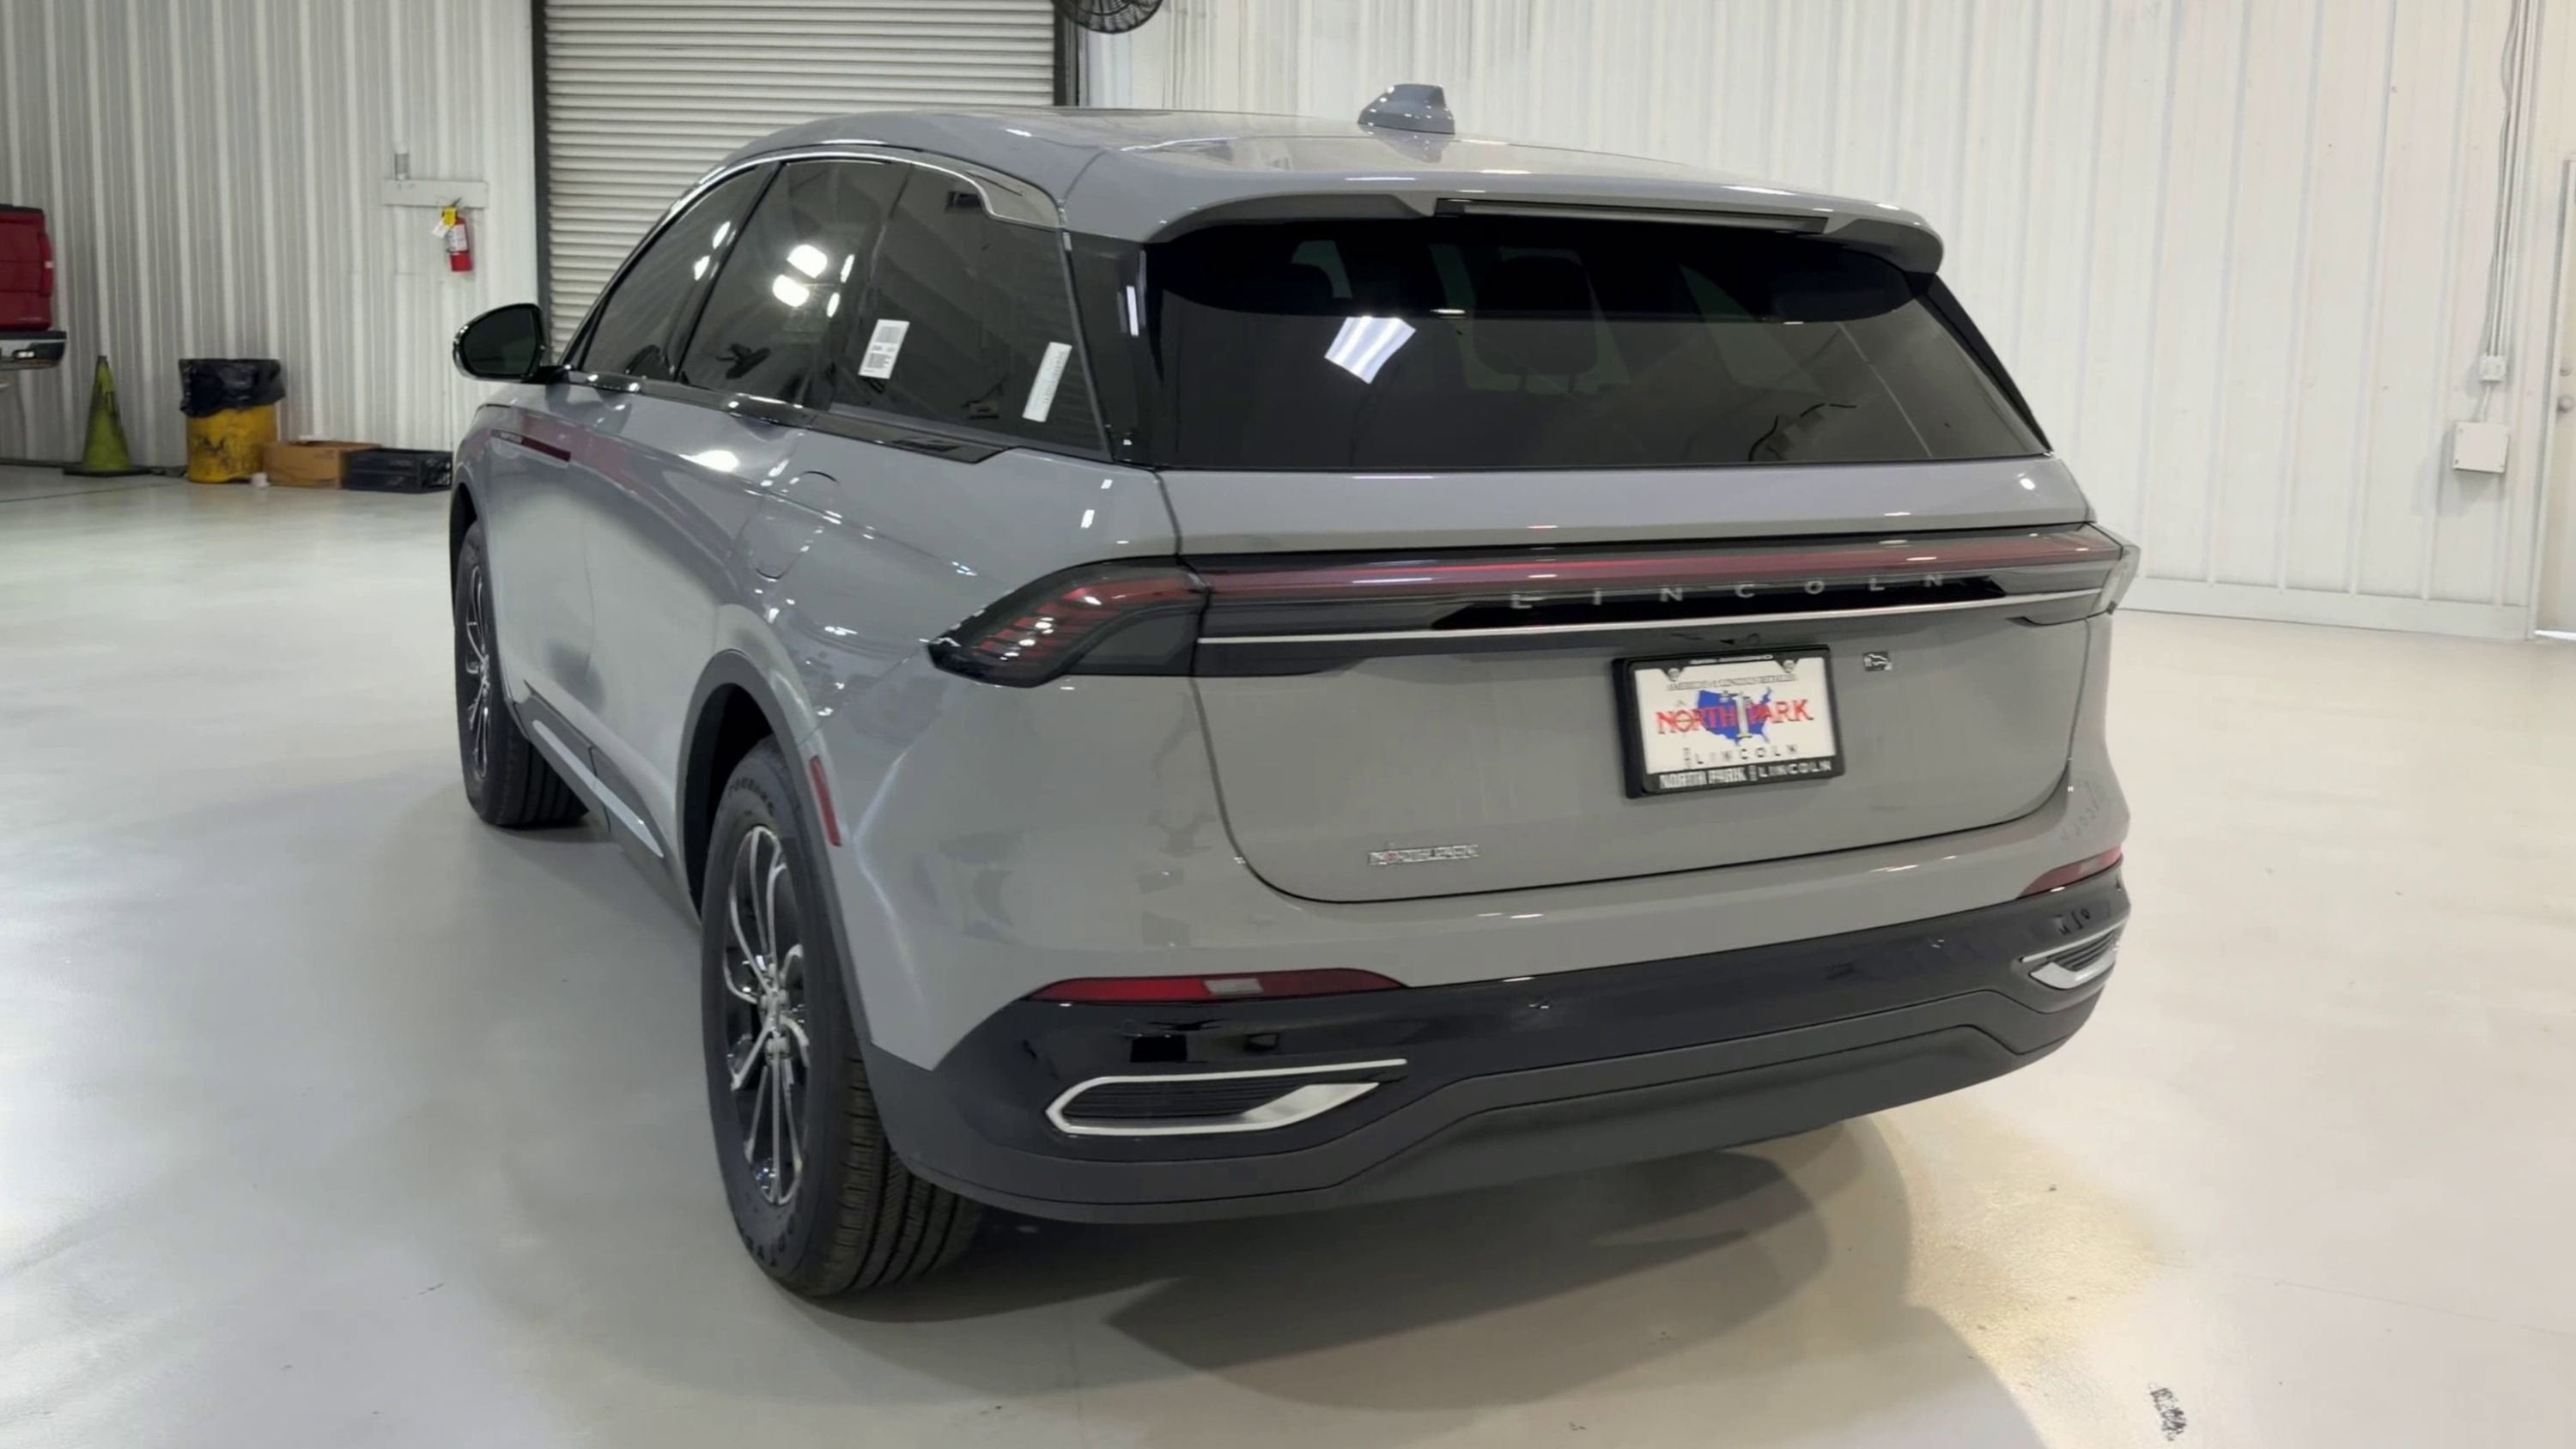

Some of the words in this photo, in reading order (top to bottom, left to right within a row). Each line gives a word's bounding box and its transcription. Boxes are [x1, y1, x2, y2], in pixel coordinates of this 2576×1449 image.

[1511, 573, 1944, 609] LINCOLN
[1656, 704, 1736, 733] NORTH
[1746, 699, 1814, 724] PARK
[1694, 744, 1797, 764] LINCOLN
[1758, 760, 1832, 778] LINCOLN
